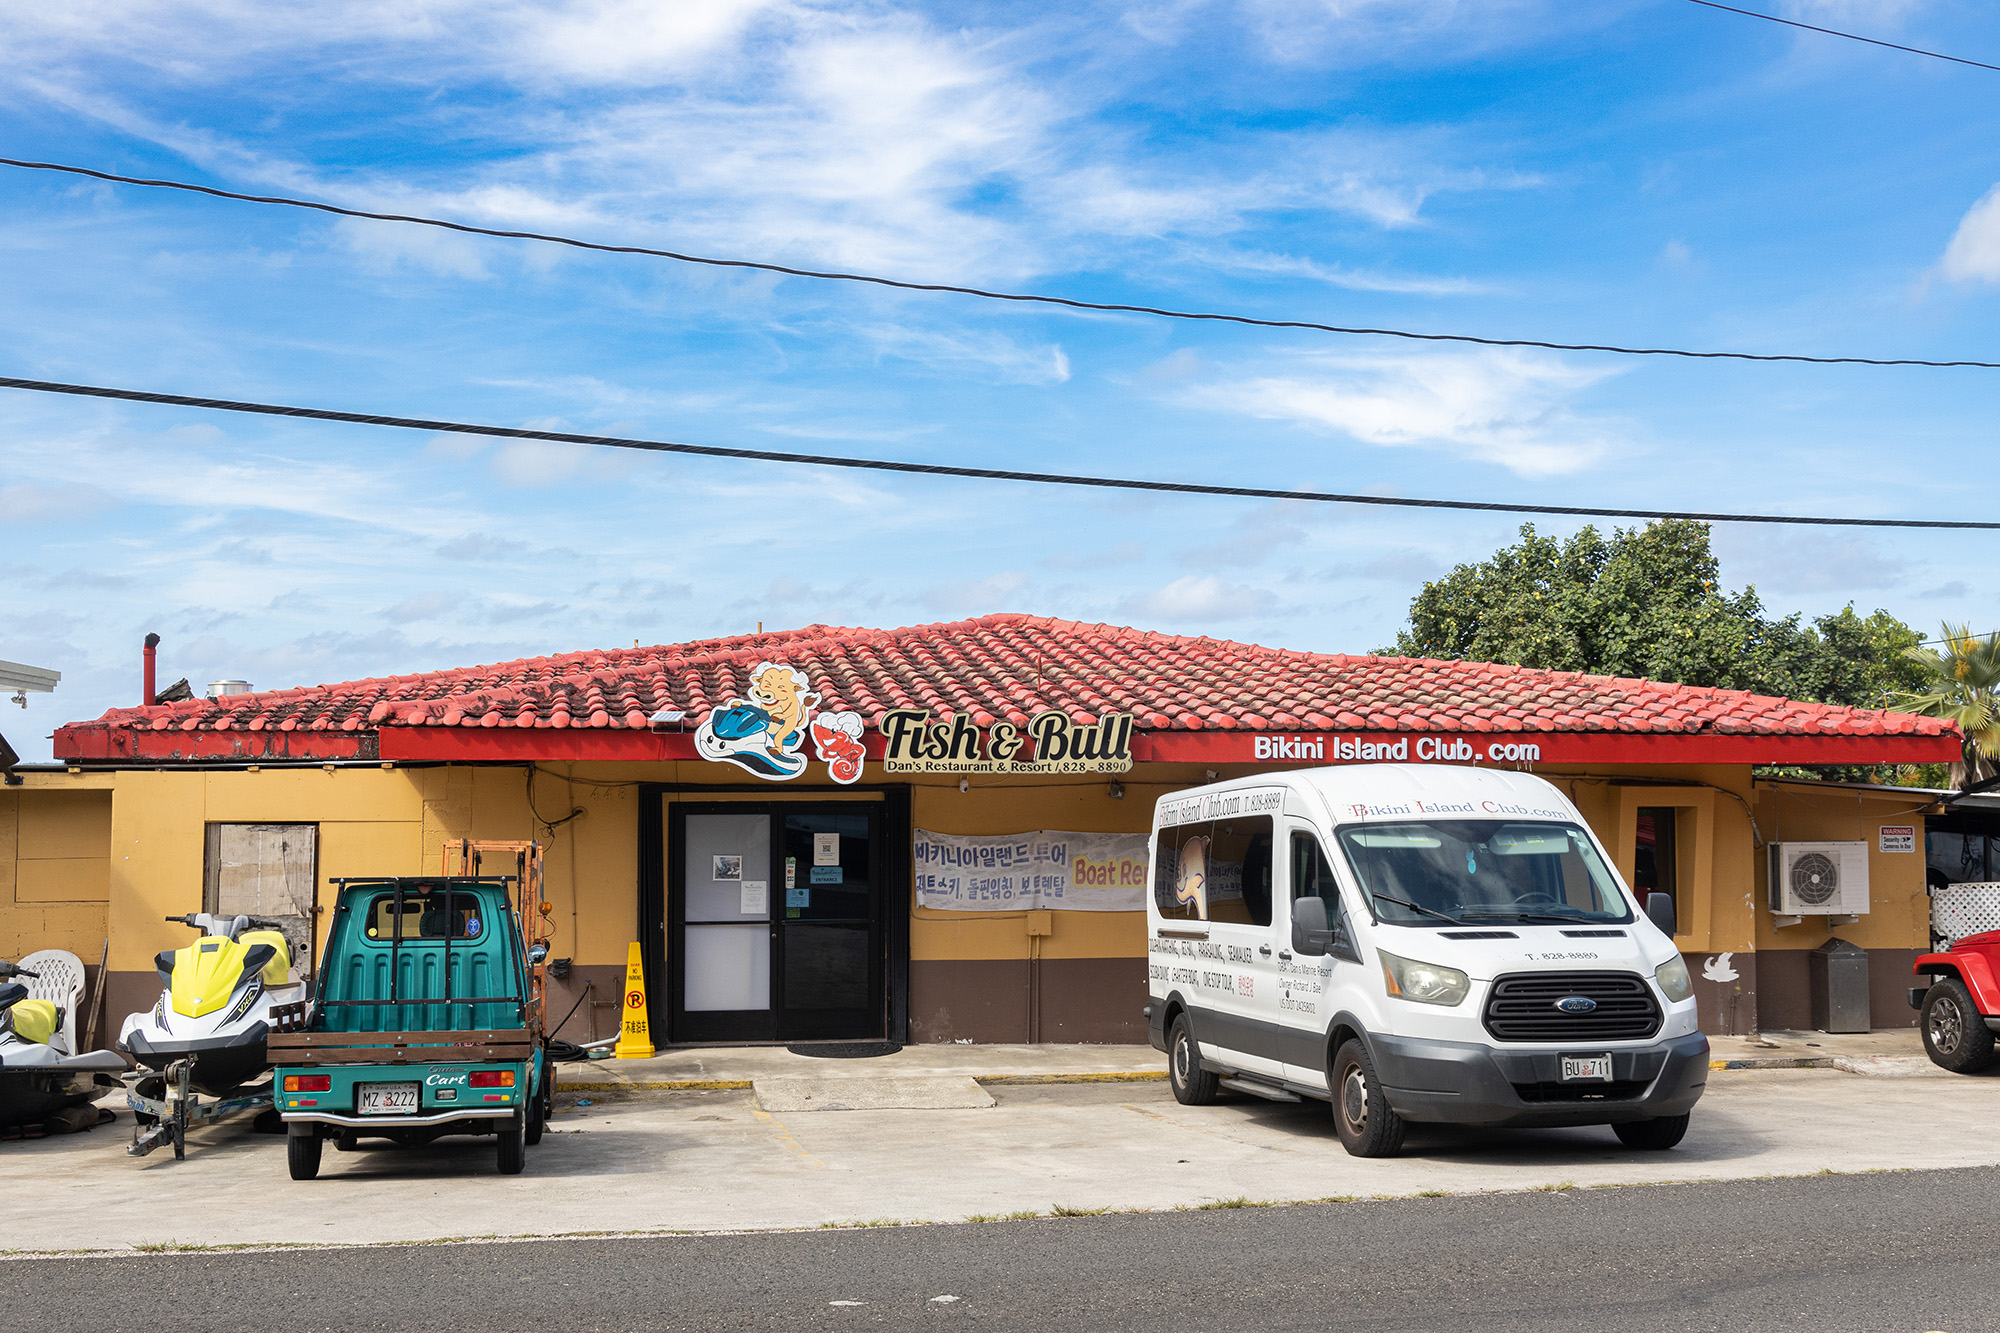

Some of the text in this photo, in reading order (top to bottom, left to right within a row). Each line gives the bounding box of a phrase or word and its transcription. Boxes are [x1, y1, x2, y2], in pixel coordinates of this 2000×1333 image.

[881, 711, 1131, 760] Fish & Bull
[1254, 736, 1324, 760] Bikini
[1333, 736, 1408, 761] Island
[887, 761, 921, 772] Dan's
[925, 761, 993, 772] Restaurant
[997, 762, 1007, 772] &
[1011, 762, 1052, 772] Resort
[1097, 762, 1127, 772] 8890
[1159, 803, 1178, 827] Bikini
[1179, 797, 1201, 824] Island
[1202, 794, 1241, 819] Club.com
[1350, 800, 1568, 819] Bikini Island Club.com
[914, 841, 1067, 868] 비키니아일랜드 투어
[1075, 858, 1116, 885] Boat
[1019, 875, 1066, 898] 보트렌탈
[1524, 952, 1599, 961] T. 828-8889
[1317, 965, 1332, 978] Resort
[1566, 999, 1589, 1010] Ford
[1564, 1060, 1610, 1076] BU 711
[425, 1074, 467, 1086] Cart
[363, 1091, 415, 1107] MZ 3222
